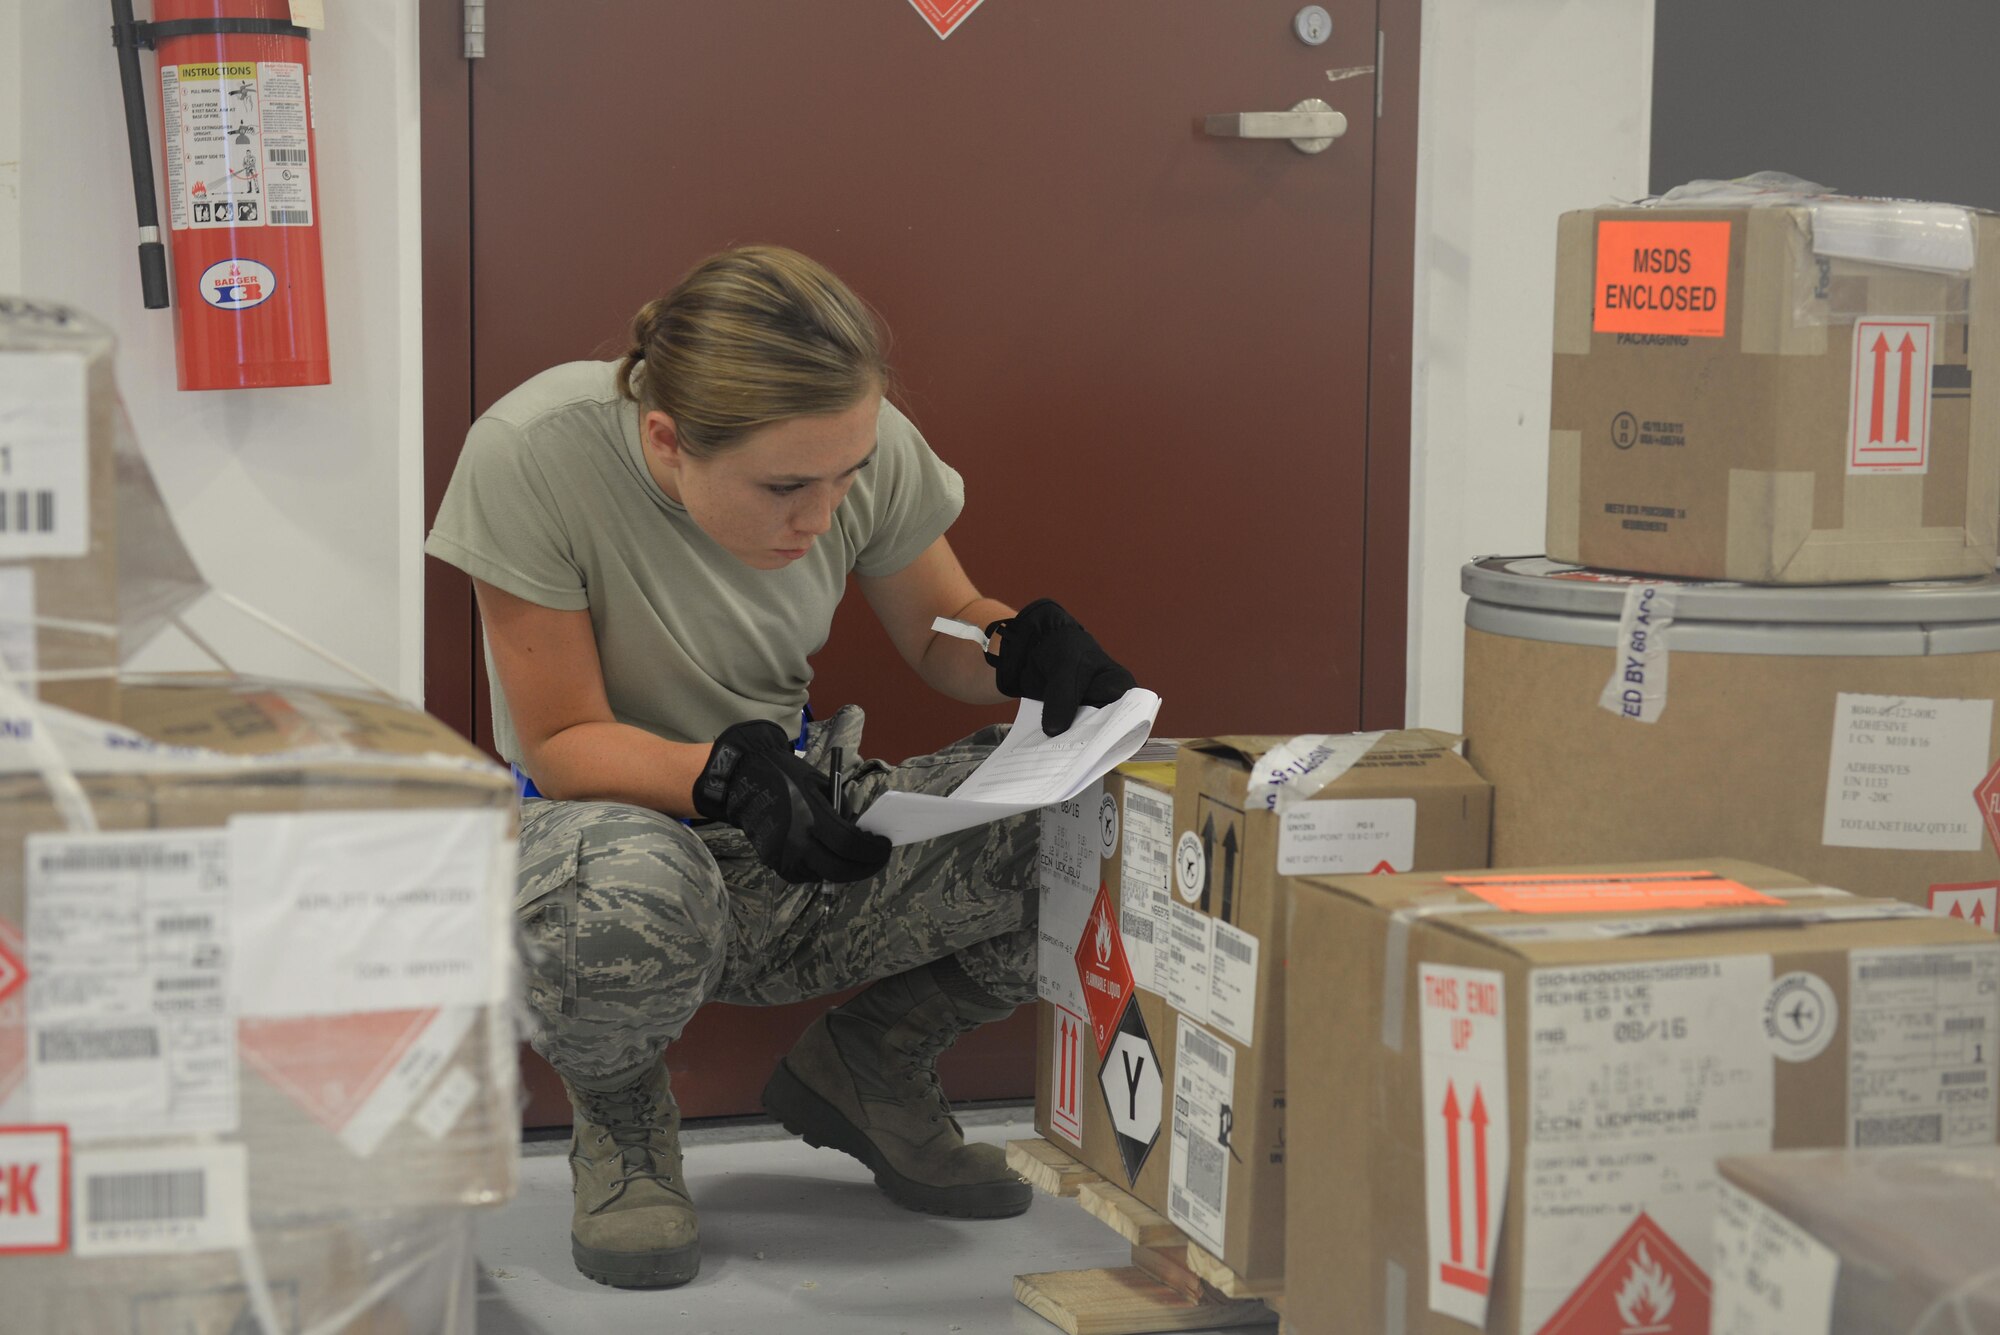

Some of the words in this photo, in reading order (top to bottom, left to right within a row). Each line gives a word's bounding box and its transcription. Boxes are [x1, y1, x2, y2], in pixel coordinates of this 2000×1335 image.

[182, 66, 251, 77] INSTRUCTIONS
[1633, 248, 1692, 274] MSDS
[214, 276, 258, 287] BADGER
[1605, 284, 1717, 311] ENCLOSED
[1630, 630, 1648, 653] 60
[1624, 656, 1646, 684] BY
[1849, 719, 1908, 733] ADHESIVE
[1845, 762, 1911, 775] ADHESIVES
[1085, 970, 1107, 993] FLAMMABLE
[1107, 979, 1121, 999] LIQUID
[1424, 975, 1458, 1011] THIS
[1466, 981, 1497, 1017] END
[1099, 1024, 1104, 1041] 3
[1450, 1018, 1473, 1051] UP
[1614, 1017, 1688, 1043] 08/16
[1974, 1044, 1983, 1064] 1
[1122, 1049, 1145, 1121] Y
